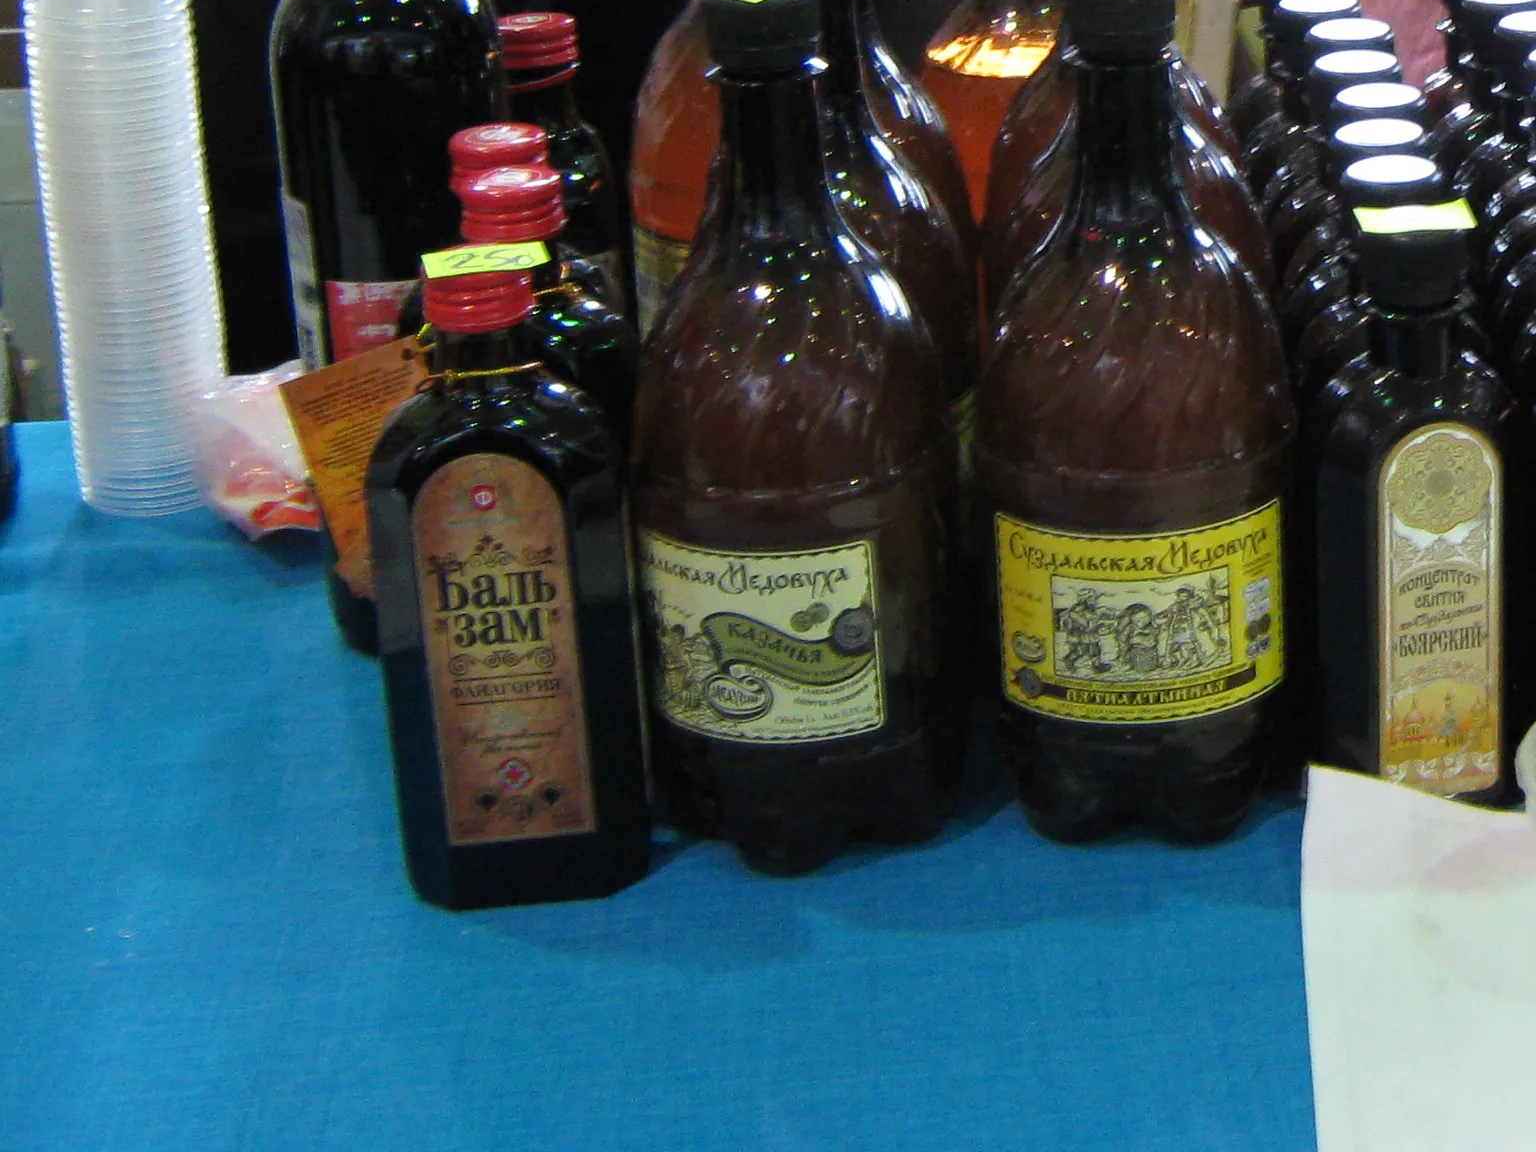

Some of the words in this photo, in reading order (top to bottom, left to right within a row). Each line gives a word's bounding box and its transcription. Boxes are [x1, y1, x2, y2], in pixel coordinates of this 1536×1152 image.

[443, 248, 535, 269] 250
[432, 557, 558, 613] Баль
[453, 607, 545, 649] зам
